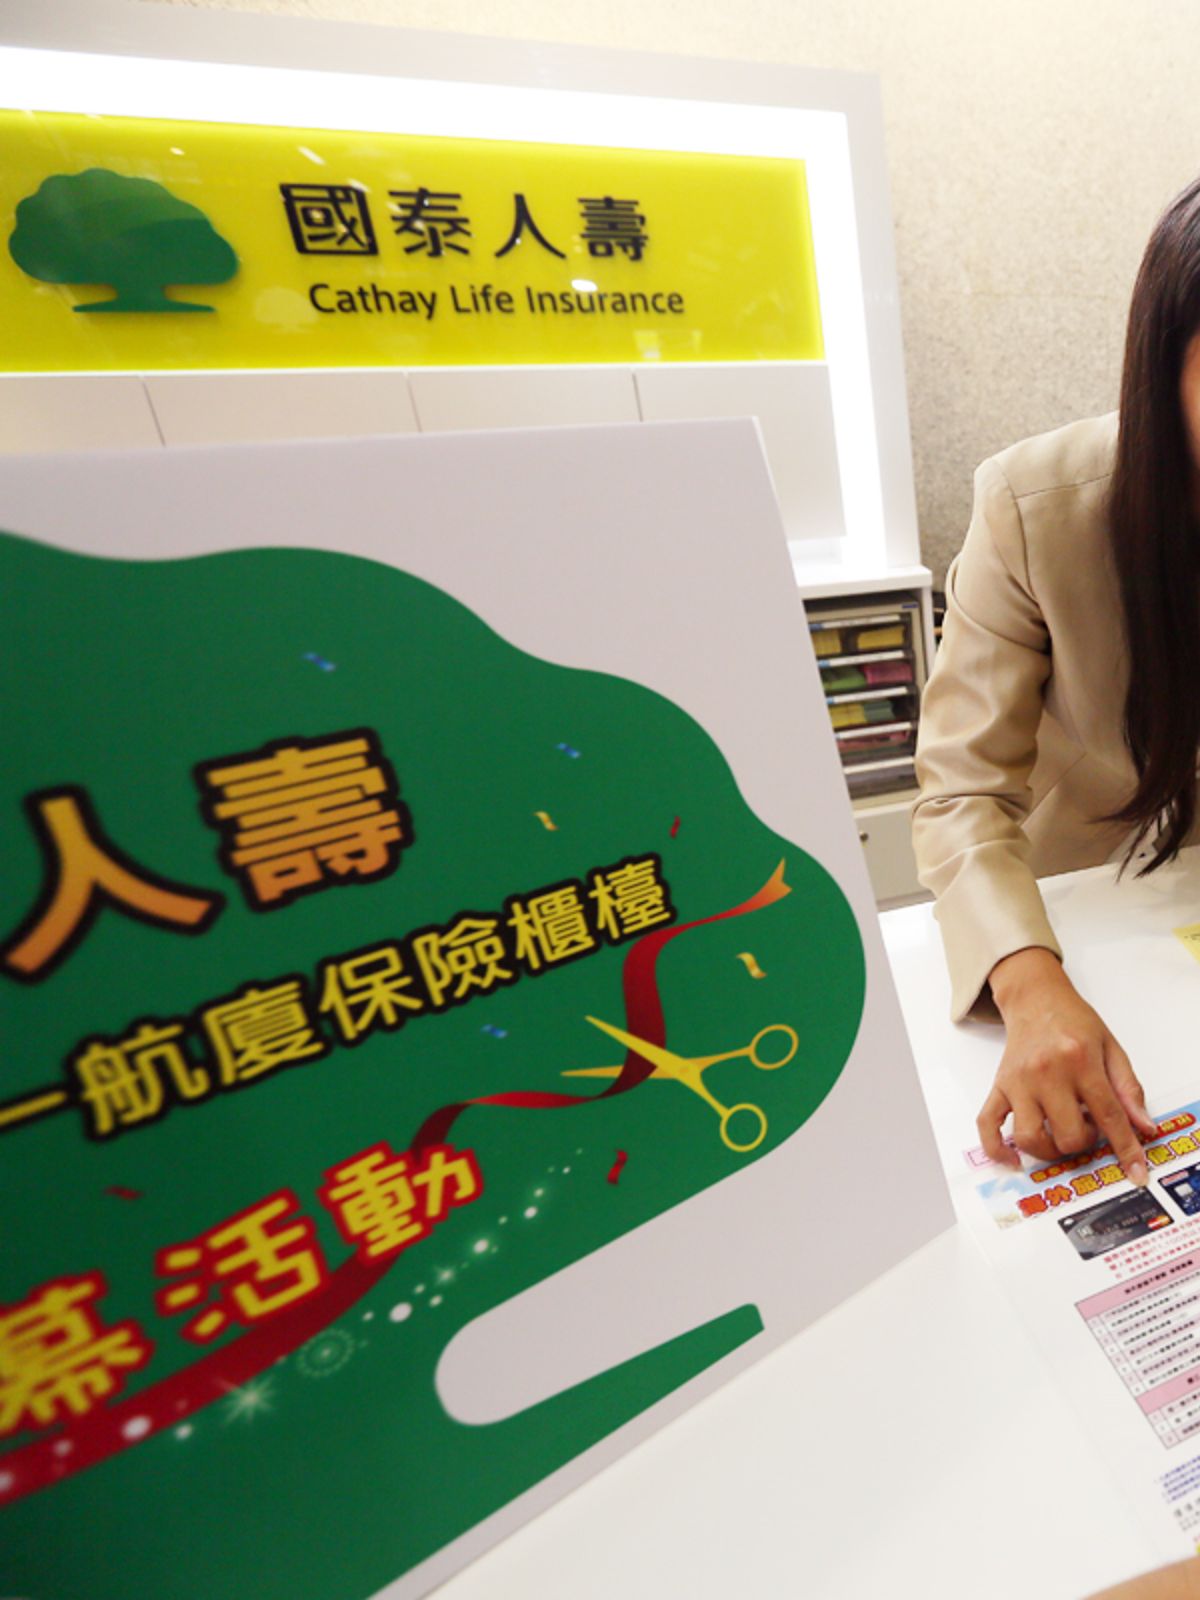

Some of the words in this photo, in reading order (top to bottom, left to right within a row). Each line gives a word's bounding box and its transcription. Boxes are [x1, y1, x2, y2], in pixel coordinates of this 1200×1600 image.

[279, 182, 648, 261] 國泰人壽
[309, 283, 438, 319] Cathay
[453, 284, 514, 314] Life
[528, 286, 685, 315] Insurance
[2, 730, 410, 980] 人壽
